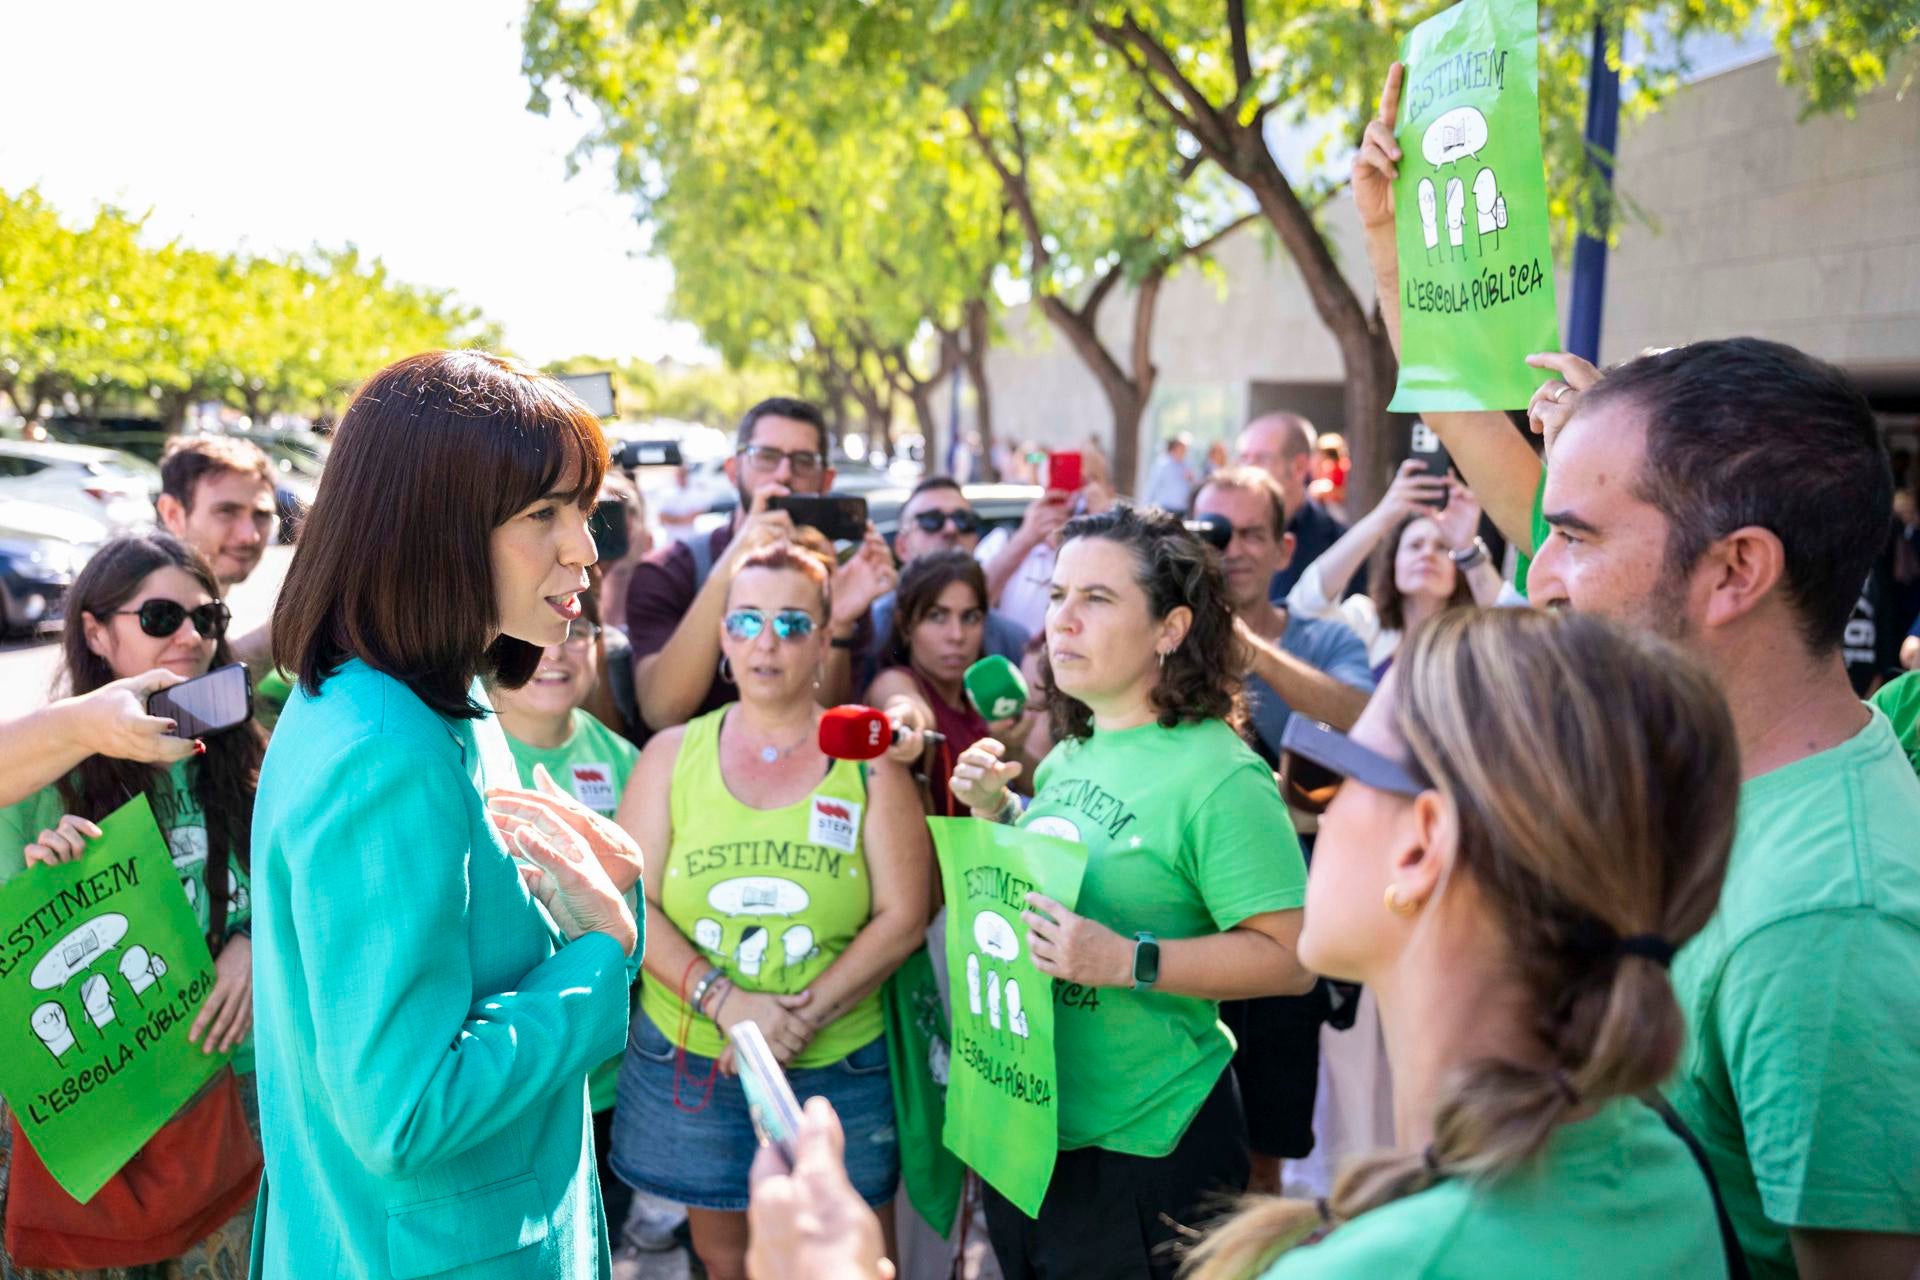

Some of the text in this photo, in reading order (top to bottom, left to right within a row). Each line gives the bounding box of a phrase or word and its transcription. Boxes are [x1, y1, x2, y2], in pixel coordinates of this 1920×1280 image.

[1410, 49, 1508, 123] ESTIMEM
[1407, 278, 1469, 313] L'ESCOLA
[685, 839, 844, 880] ESTIMEM
[0, 856, 140, 979] ESTIMEM
[28, 1043, 135, 1125] L'ESCOLA
